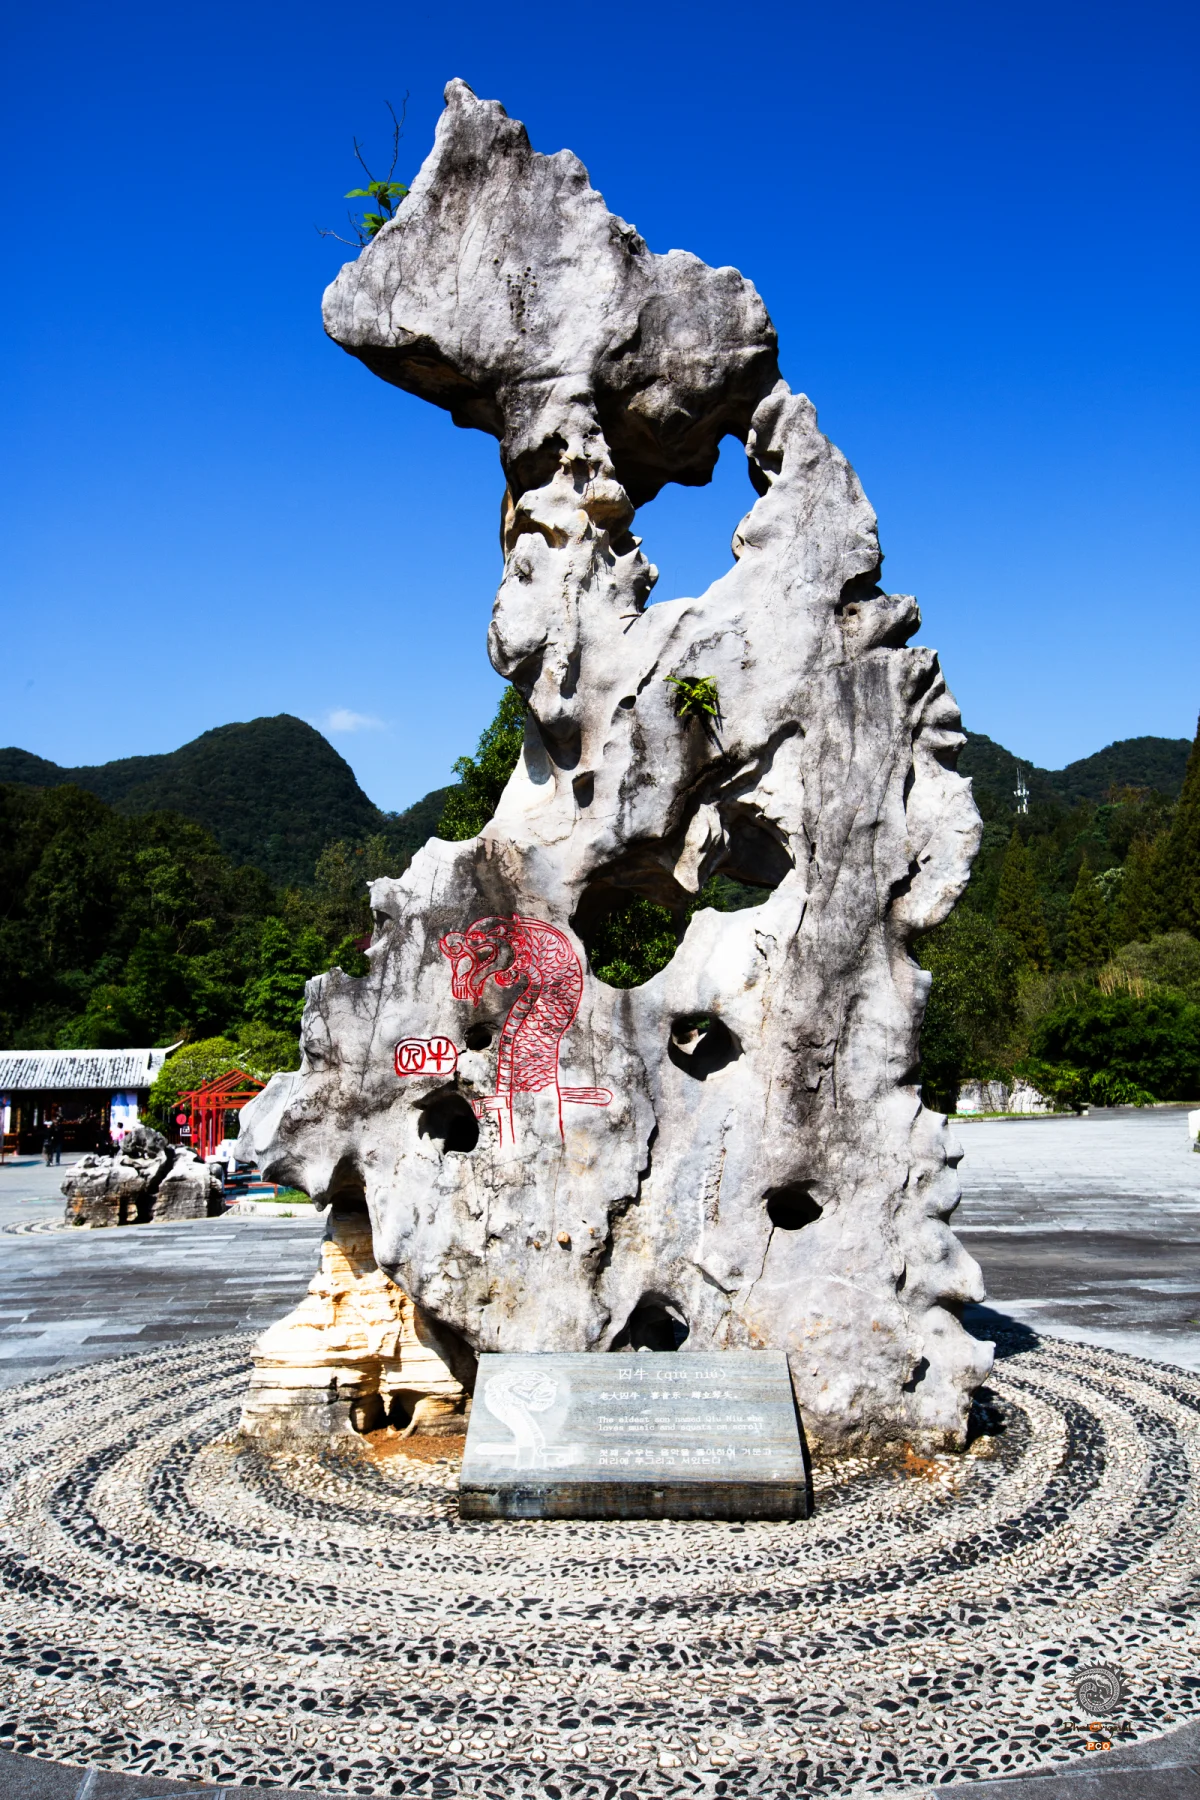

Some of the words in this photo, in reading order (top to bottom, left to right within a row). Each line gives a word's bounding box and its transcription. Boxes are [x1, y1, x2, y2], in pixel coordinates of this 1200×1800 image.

[619, 1367, 649, 1381] 囚牛
[599, 1423, 624, 1431] loves
[628, 1423, 654, 1431] music
[680, 1424, 710, 1432] squats
